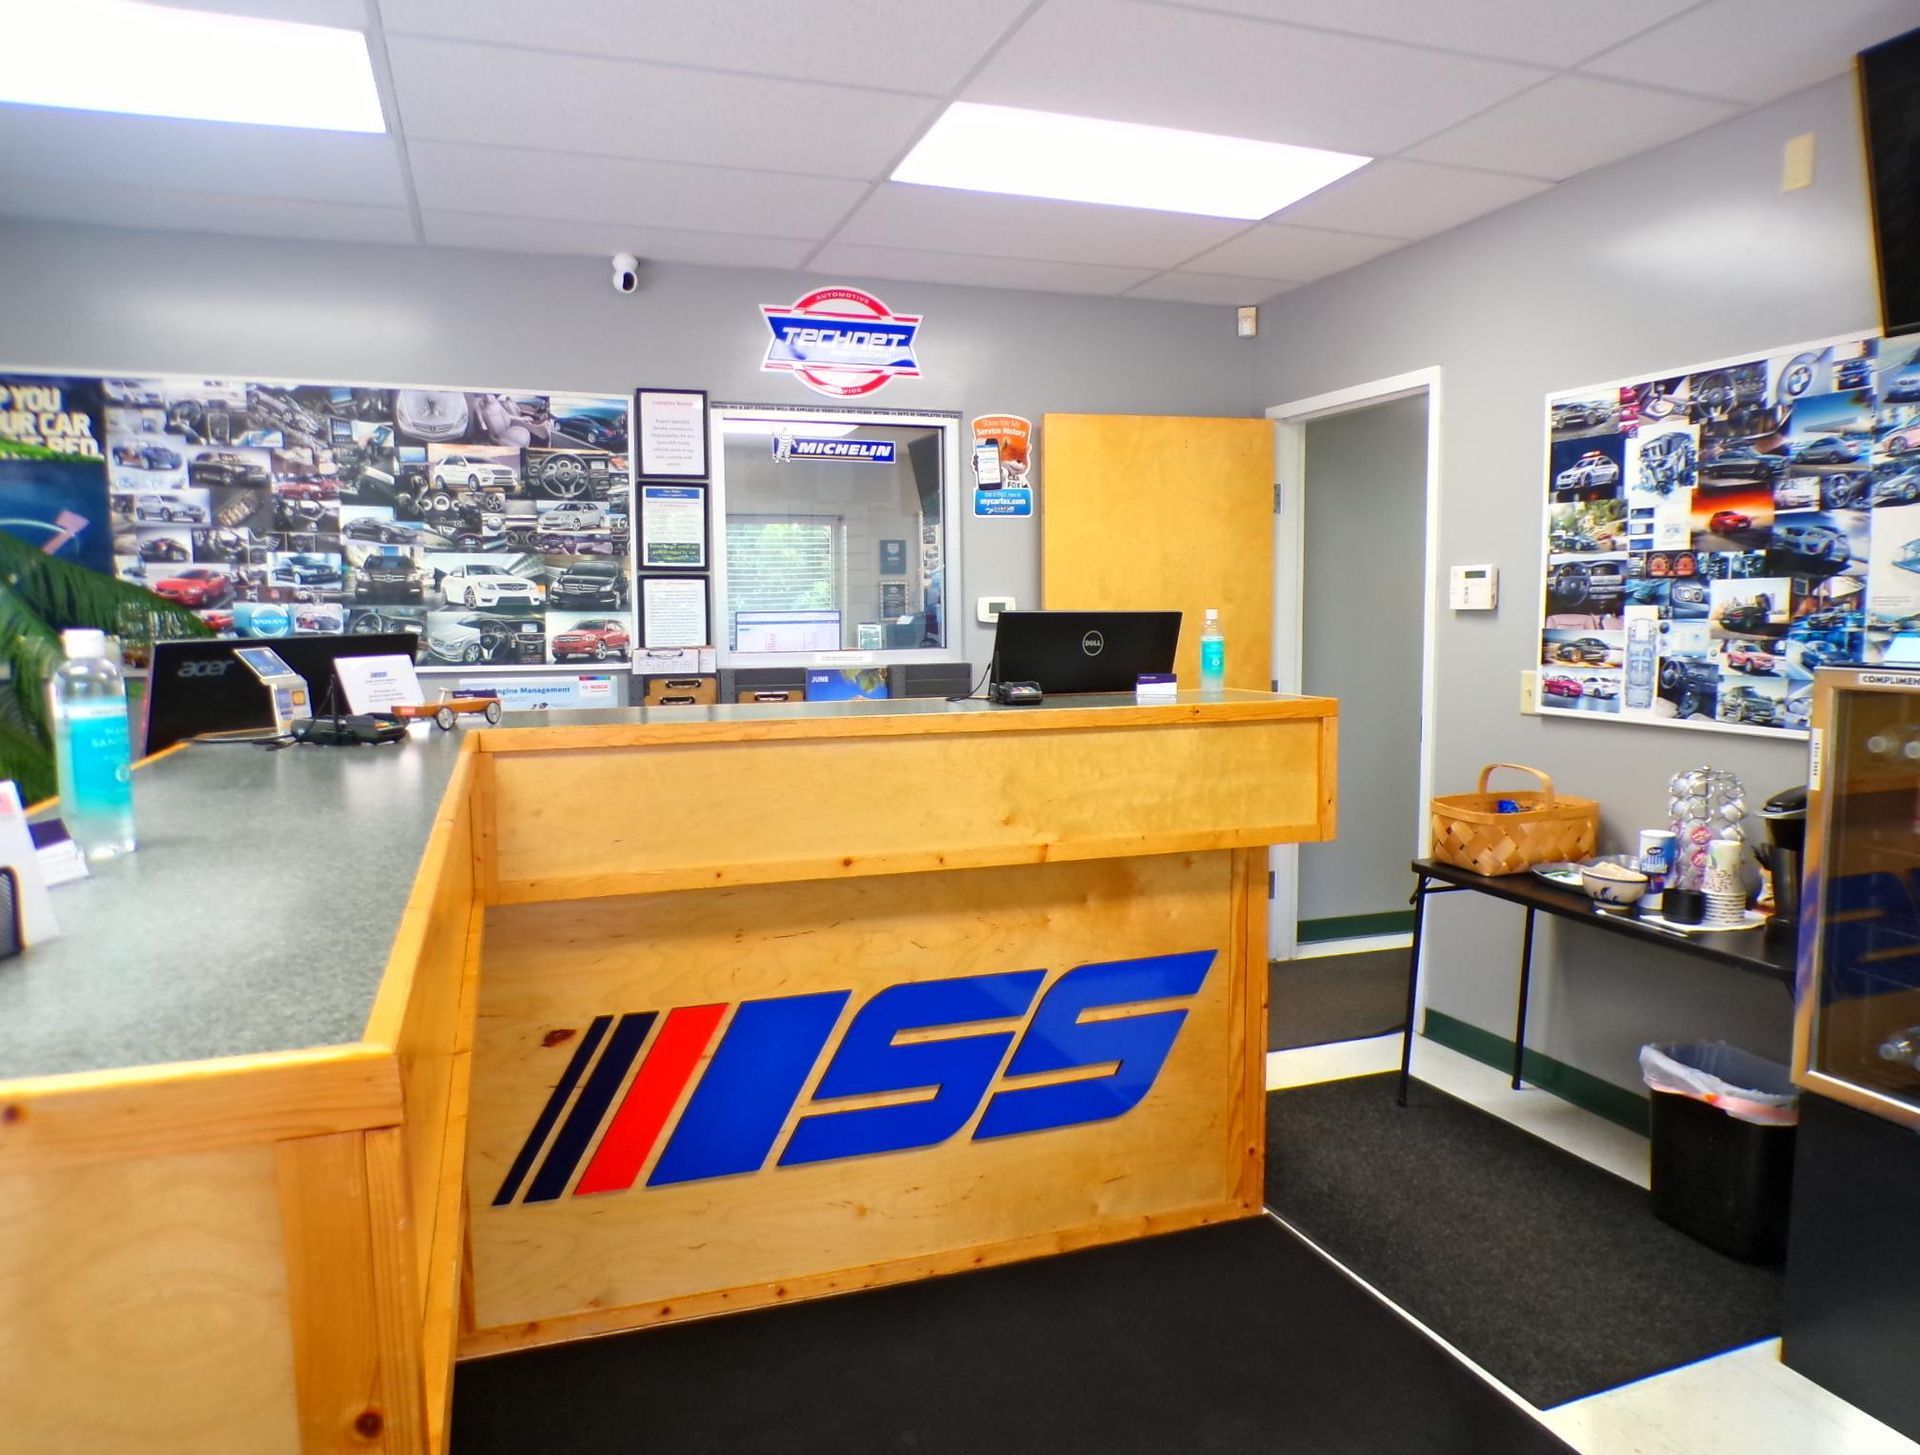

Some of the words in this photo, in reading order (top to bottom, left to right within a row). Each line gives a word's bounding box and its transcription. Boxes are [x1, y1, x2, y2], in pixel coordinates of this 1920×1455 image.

[816, 291, 870, 304] AUTOMOTIVE
[10, 387, 61, 411] YOU
[39, 412, 91, 437] CAR
[976, 428, 1002, 437] Service
[1002, 427, 1026, 438] History
[797, 442, 892, 457] MICHELIN
[980, 497, 1026, 506] mycarfax.com
[178, 659, 234, 678] acer
[520, 686, 570, 695] Management
